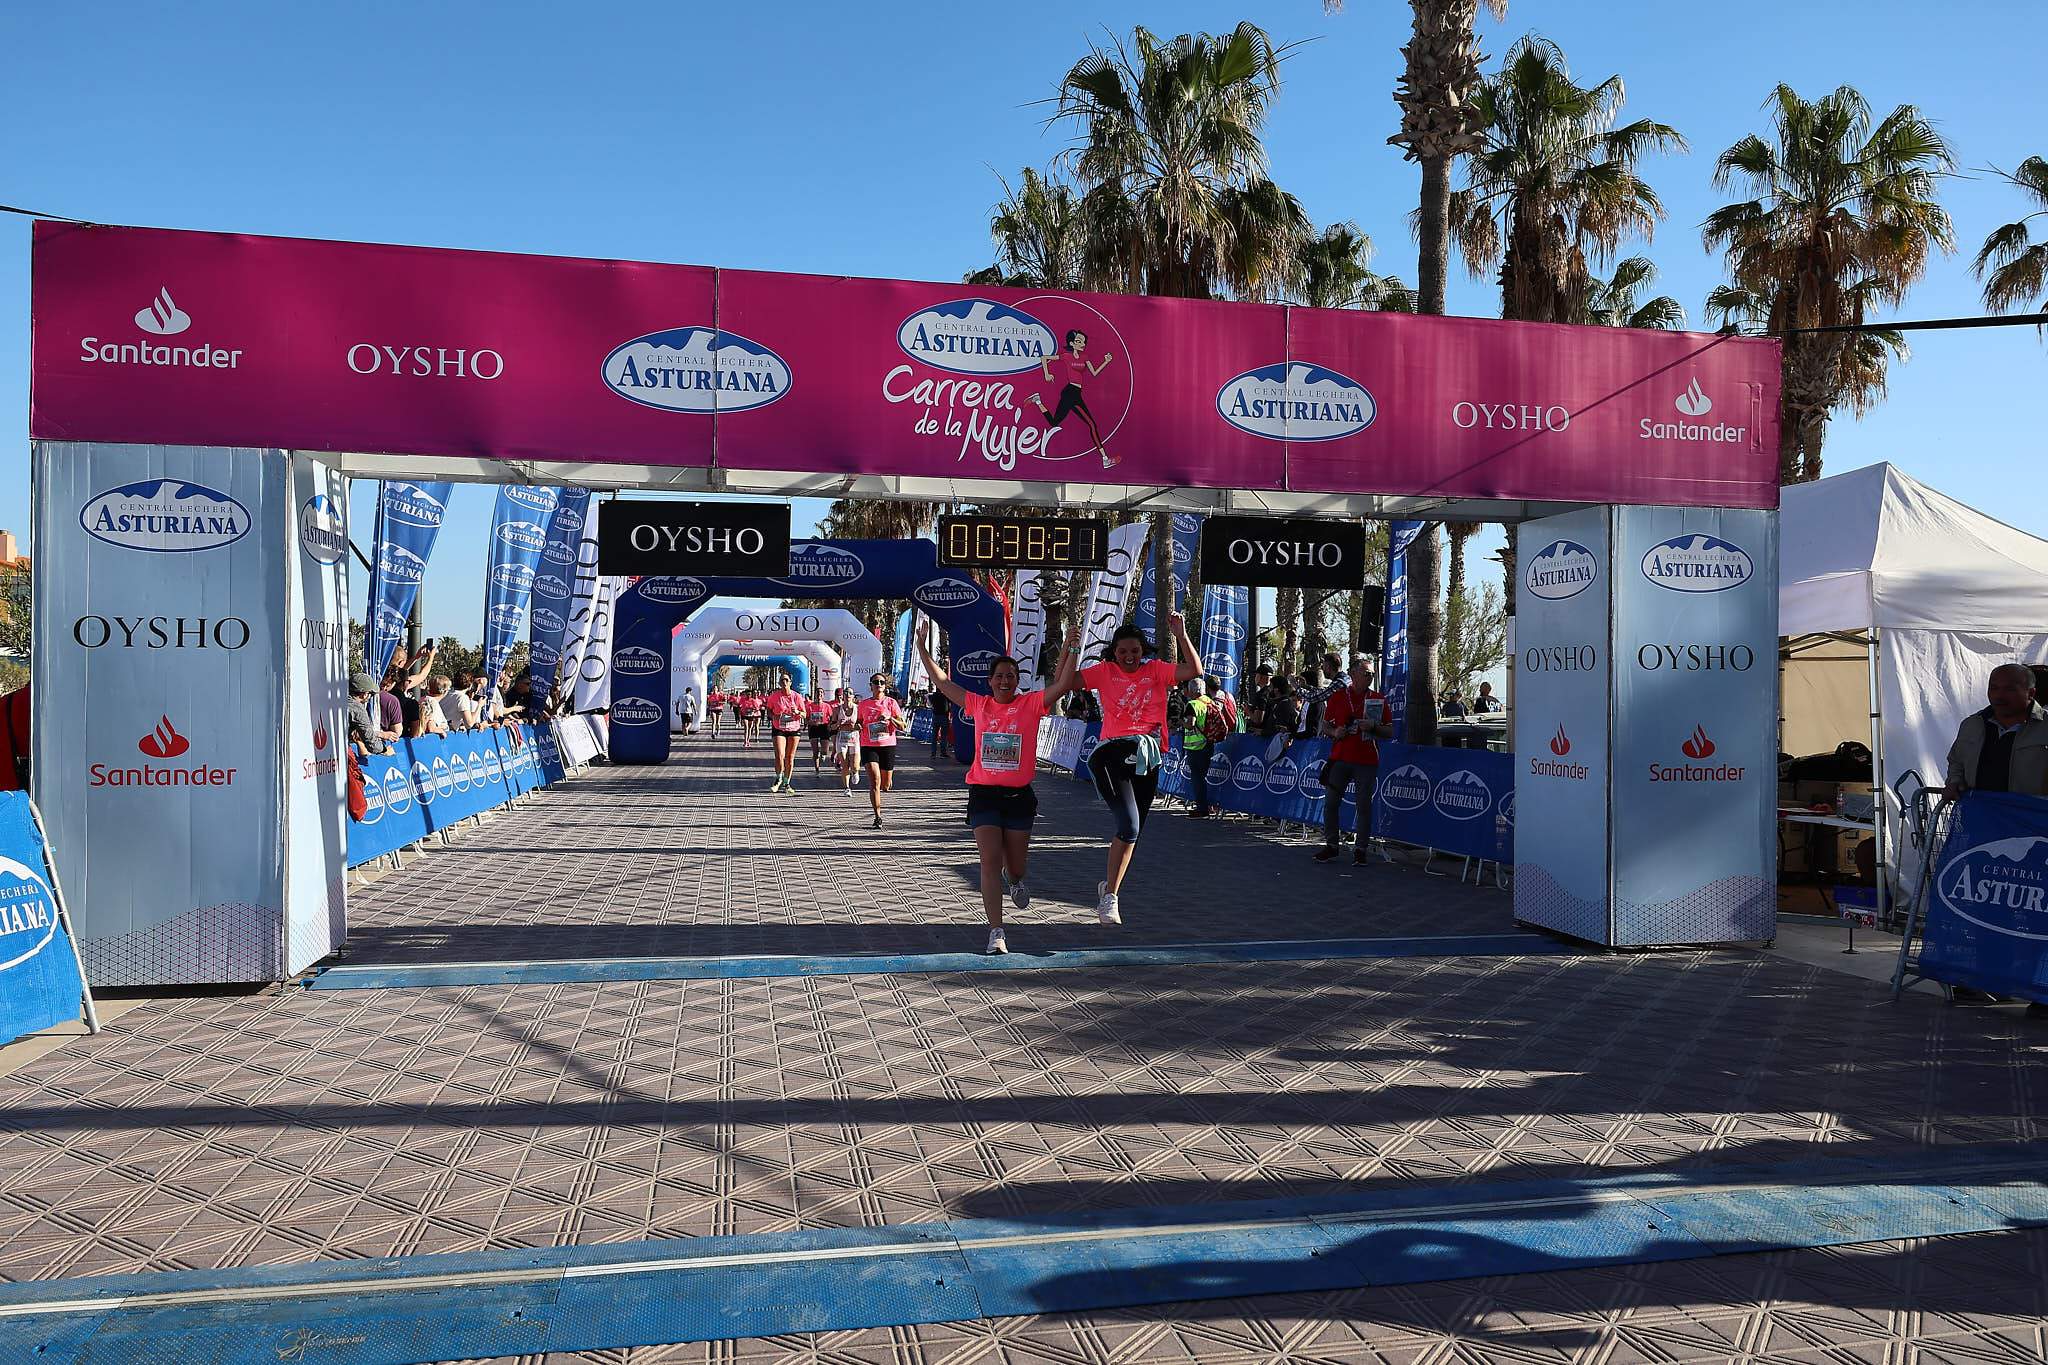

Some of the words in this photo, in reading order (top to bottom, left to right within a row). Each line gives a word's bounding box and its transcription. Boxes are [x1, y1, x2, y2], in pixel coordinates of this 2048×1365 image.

[910, 322, 1044, 358] ASTURIANA
[935, 322, 986, 333] CENTRAL
[990, 325, 1041, 336] LECHERA
[81, 337, 242, 369] Santander
[347, 342, 504, 380] OYSHO
[646, 355, 706, 366] CENTRAL
[616, 355, 777, 392] ASTURIANA
[882, 364, 1015, 410] Carrera
[1309, 390, 1360, 400] LECHERA
[1229, 387, 1364, 423] ASTURIANA
[1452, 401, 1570, 432] OYSHO
[914, 407, 939, 435] de
[944, 408, 962, 437] la
[958, 408, 1063, 472] Mujer
[1639, 418, 1746, 443] Santander
[93, 504, 239, 535] ASTURIANA
[120, 503, 175, 512] CENTRAL
[179, 505, 233, 514] LECHERA
[630, 524, 764, 555] OYSHO
[950, 524, 1096, 561] 00:38:21
[1228, 539, 1342, 567] OYSHO
[1666, 553, 1702, 561] CENTRAL
[1705, 554, 1742, 562] LECHERA
[1530, 564, 1591, 588] ASTURIANA
[1650, 554, 1744, 579] ASTURIANA
[642, 583, 701, 596] ASTURIANA
[919, 586, 976, 602] ASTURIANA
[73, 615, 250, 650] OYSHO
[300, 617, 344, 651] OYSHO
[580, 581, 610, 683] OYSH
[684, 632, 711, 640] OYSHO
[736, 614, 820, 634] OYSHO
[843, 633, 868, 641] OYSHO
[614, 656, 661, 670] ASTURIANA
[1526, 644, 1596, 672] OYSHO
[1638, 644, 1754, 671] OYSHO
[612, 706, 659, 720] ASTURIANA
[90, 764, 237, 786] Santander
[1531, 758, 1589, 781] Santander
[1649, 764, 1746, 782] Santander
[1383, 780, 1426, 801] ASTURIANA
[1436, 785, 1484, 811] ASTURIANA
[1982, 863, 2044, 881] CENTRAL
[0, 885, 39, 898] ECHERA
